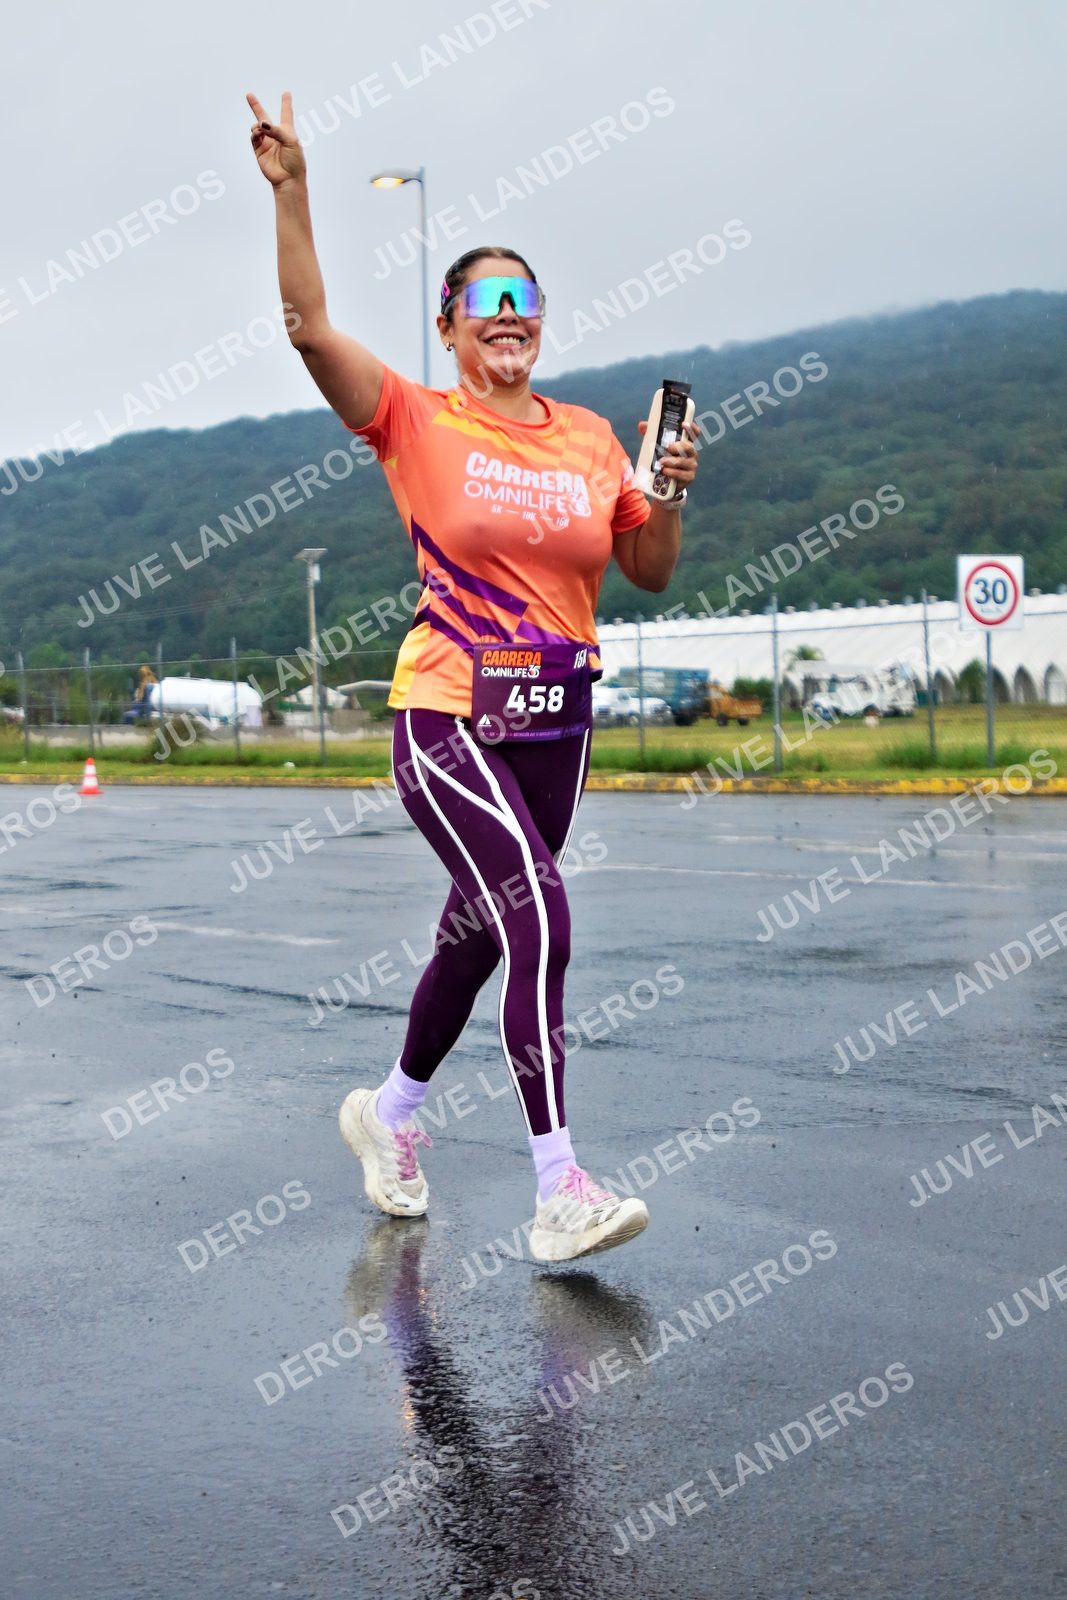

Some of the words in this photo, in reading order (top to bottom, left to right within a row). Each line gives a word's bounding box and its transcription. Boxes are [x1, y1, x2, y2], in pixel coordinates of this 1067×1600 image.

[466, 451, 589, 500] CARRERA
[464, 480, 567, 513] OMNILIFE
[974, 578, 1008, 605] 30
[482, 650, 542, 666] CARRERA
[481, 666, 528, 678] OMNILIFE
[506, 685, 565, 713] 458
